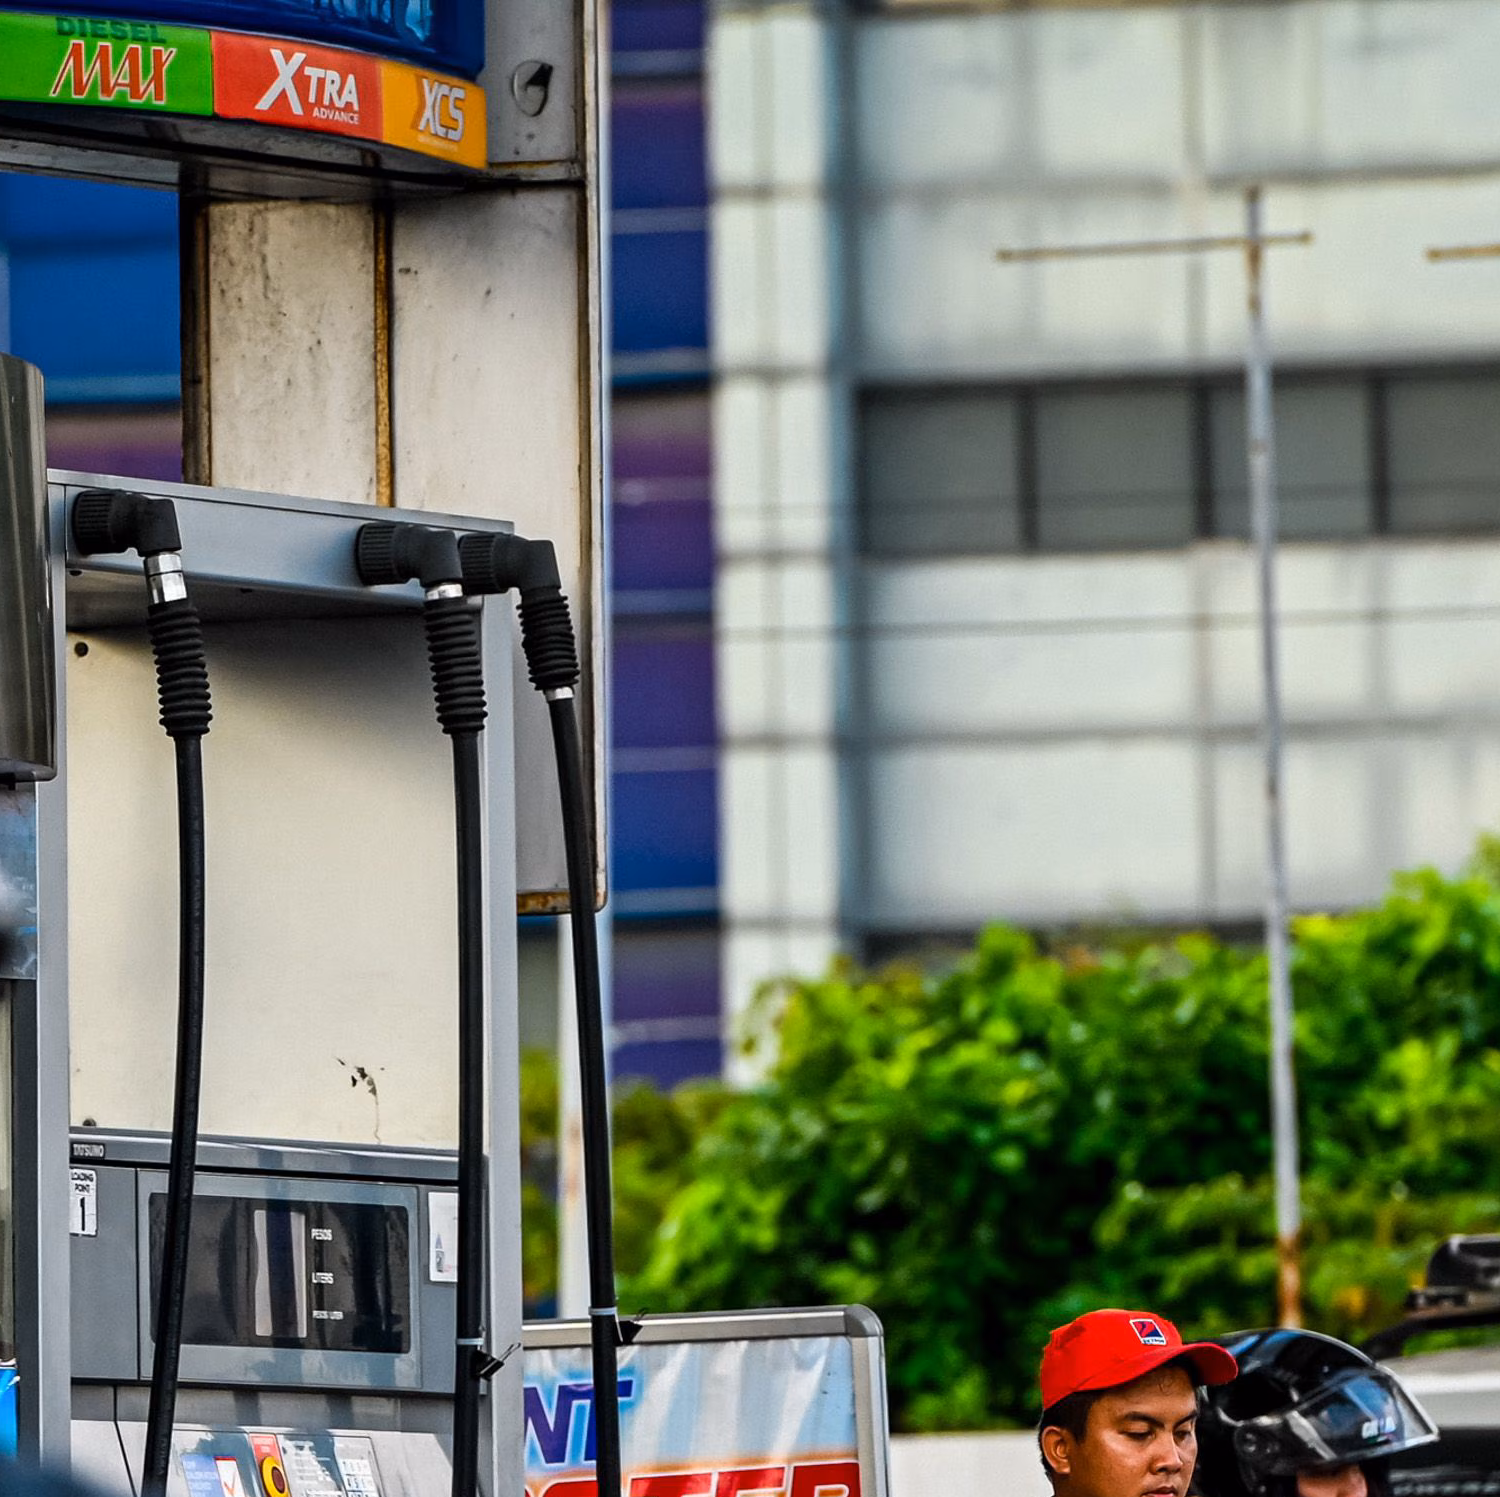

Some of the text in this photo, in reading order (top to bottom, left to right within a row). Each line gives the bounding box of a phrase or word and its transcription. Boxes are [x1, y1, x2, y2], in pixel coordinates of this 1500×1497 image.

[56, 17, 166, 43] DIESEL
[50, 40, 177, 105] MAX
[254, 48, 359, 116] XTRA
[312, 106, 360, 125] ADVANCE
[418, 78, 467, 142] XCS
[80, 1196, 86, 1231] 1
